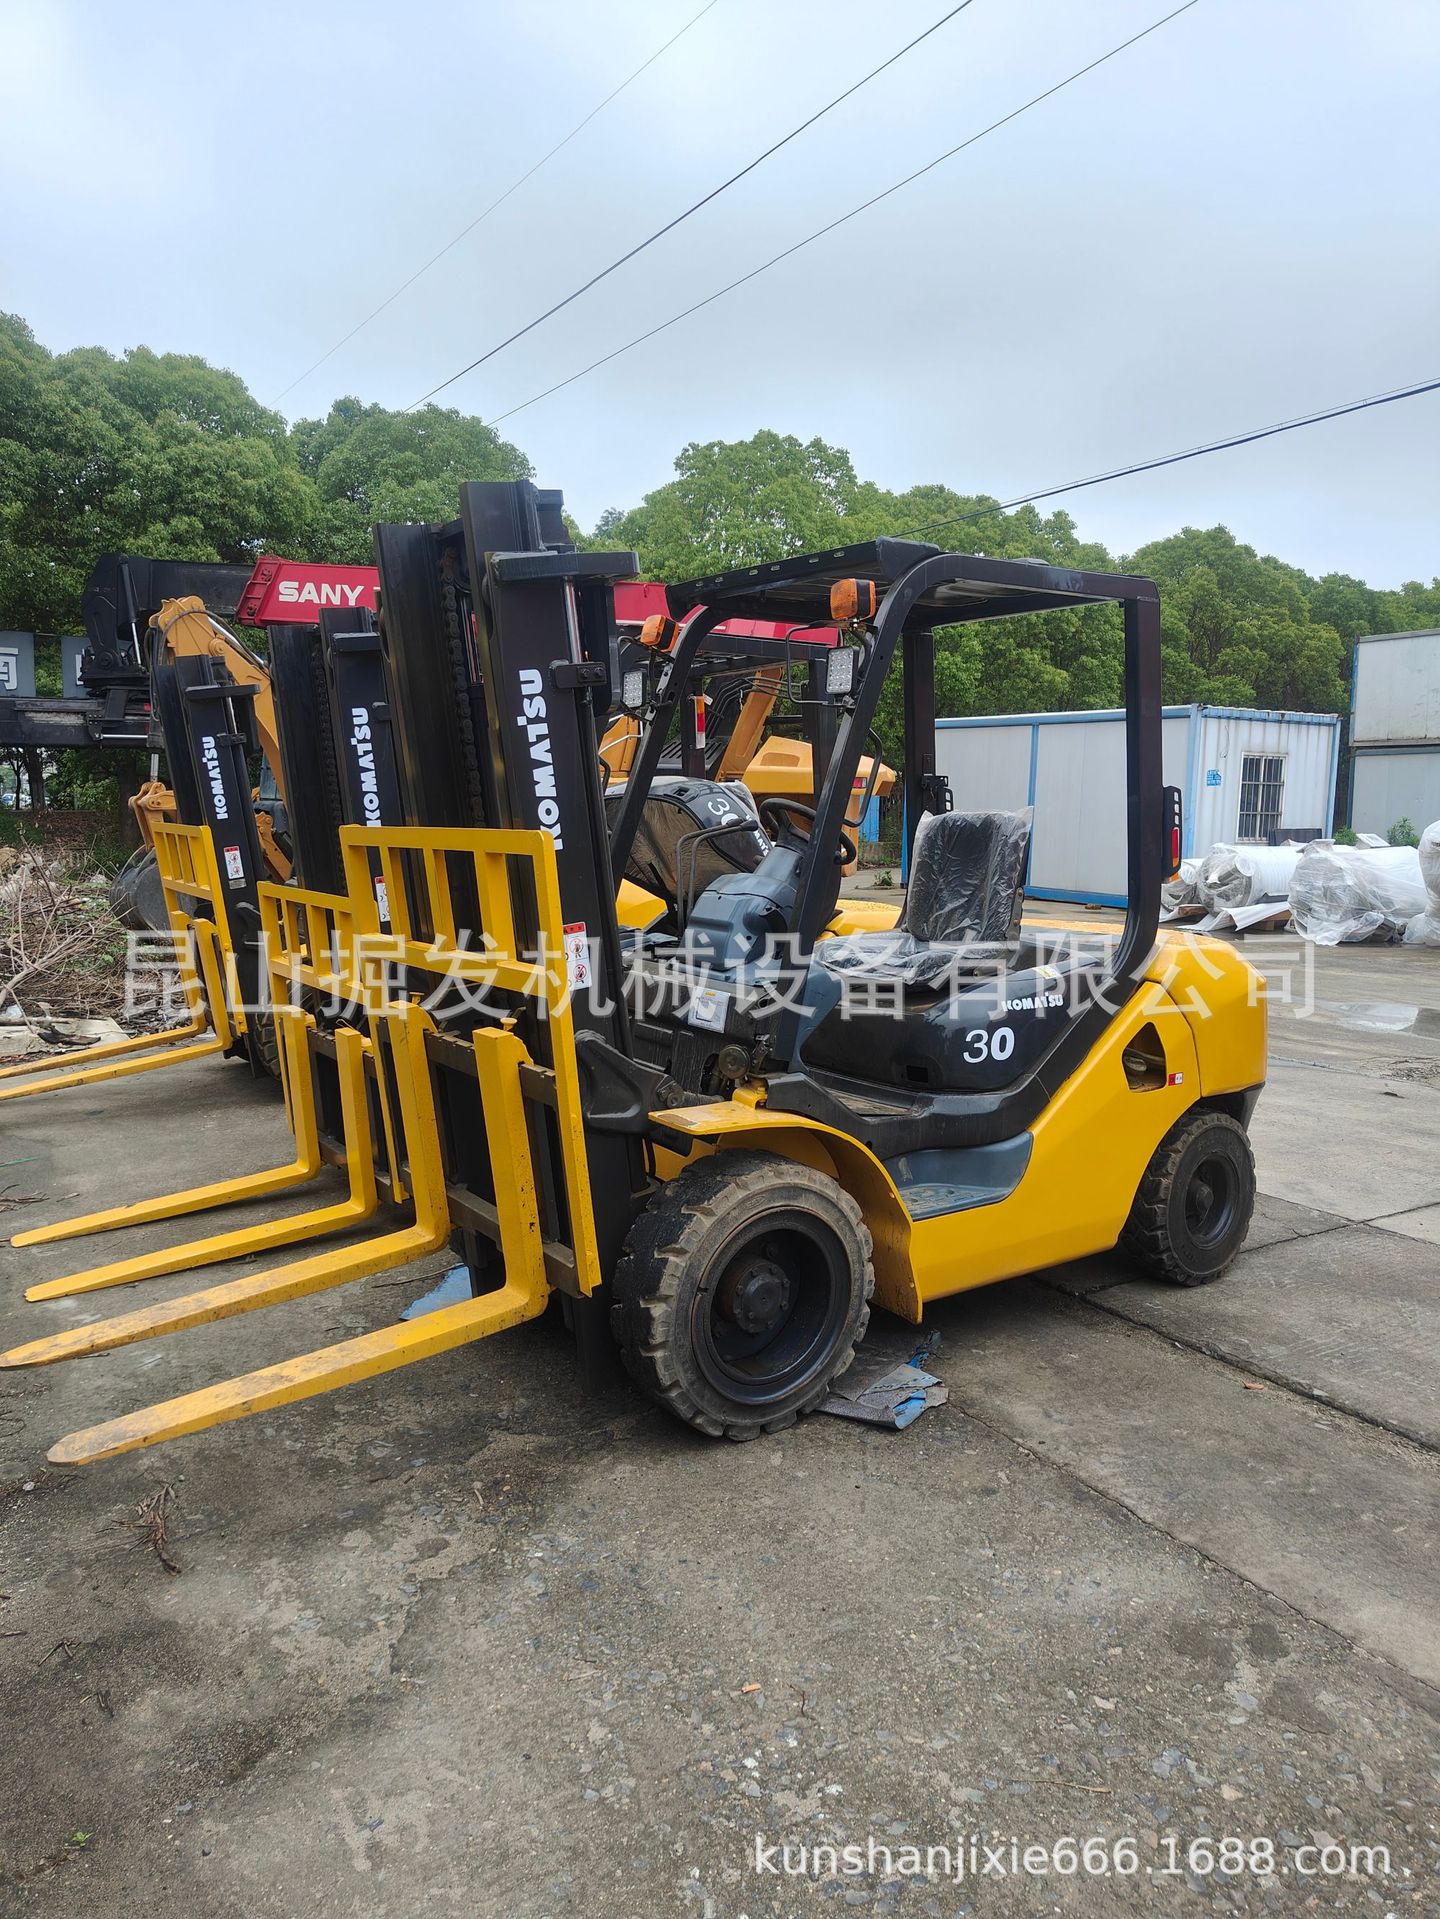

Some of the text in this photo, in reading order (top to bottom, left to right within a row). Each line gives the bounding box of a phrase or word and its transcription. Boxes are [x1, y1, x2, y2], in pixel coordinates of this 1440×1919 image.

[278, 580, 364, 606] SANY
[202, 736, 229, 820] KOMATSU
[351, 707, 382, 827] KOMATSU
[517, 668, 564, 851] KOMATSU
[1001, 992, 1064, 1011] KOMATSU
[963, 1026, 1015, 1064] 30
